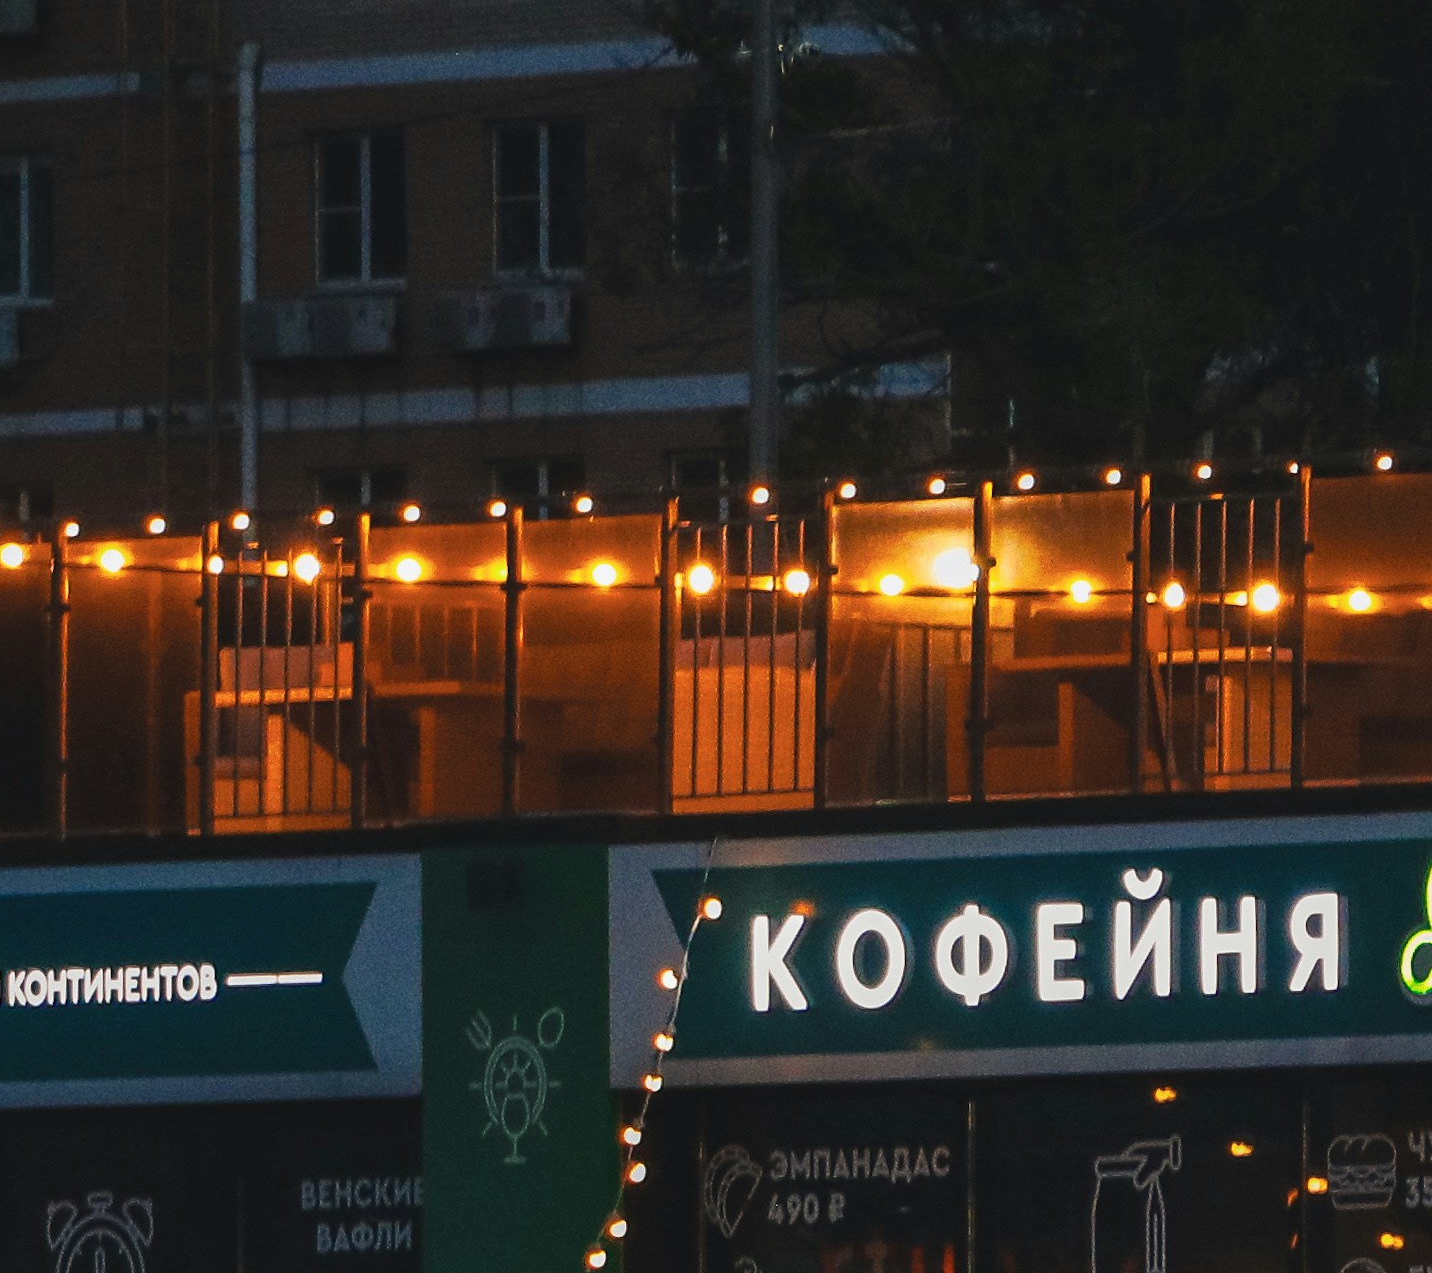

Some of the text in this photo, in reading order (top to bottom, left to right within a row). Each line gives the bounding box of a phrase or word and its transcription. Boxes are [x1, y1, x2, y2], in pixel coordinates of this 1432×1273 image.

[750, 868, 1339, 1012] КОФЕЙНЯ
[8, 961, 219, 1008] КОНТИНЕНТОВ
[769, 1146, 950, 1183] ЭМПАНАДАС
[768, 1193, 820, 1224] 490
[316, 1220, 412, 1253] ВАФЛИ
